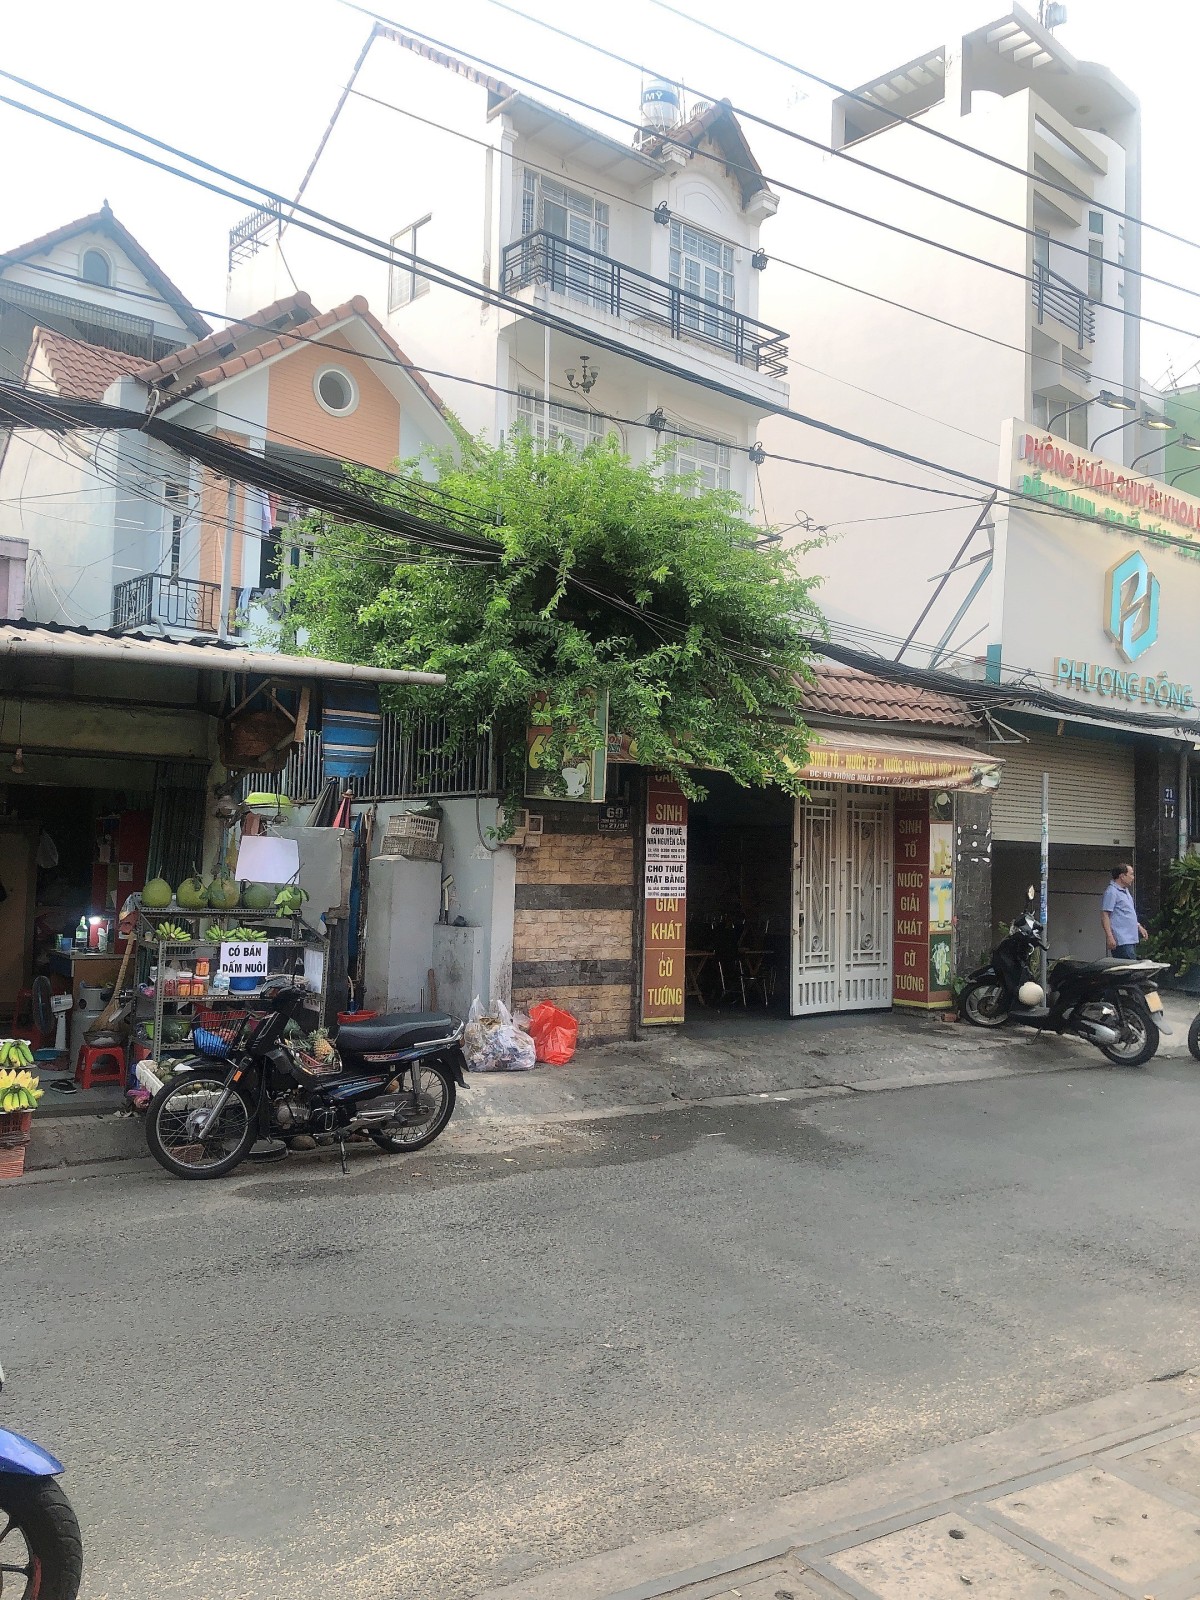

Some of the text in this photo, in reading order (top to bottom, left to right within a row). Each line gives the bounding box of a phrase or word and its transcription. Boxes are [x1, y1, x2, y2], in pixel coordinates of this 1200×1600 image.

[1023, 434, 1074, 478] PHÒNG
[1163, 495, 1195, 528] KHOA
[809, 750, 828, 766] SINH
[829, 750, 839, 768] TỐ
[846, 753, 866, 770] NƯỚC
[867, 754, 877, 771] ÉP
[883, 756, 903, 774] NƯỚC
[919, 759, 938, 776] KHÁT
[606, 807, 624, 818] 69
[655, 803, 683, 822] SINH
[650, 827, 683, 835] CHO THUÊ
[899, 819, 922, 834] SINH
[904, 839, 917, 858] TỐ
[647, 863, 684, 873] CHO THUÊ
[664, 873, 685, 884] BẰNG
[897, 870, 923, 888] NƯỚC
[900, 893, 920, 912] GIẢI
[651, 920, 683, 940] KHÁT
[897, 918, 923, 936] KHÁT
[228, 945, 262, 957] CÓ BÁN
[903, 949, 917, 967] CỜ
[222, 960, 266, 973] DẤM NUÔI
[658, 956, 674, 977] CỜ
[895, 973, 925, 992] TƯỚNG
[647, 984, 683, 1006] TƯỚNG
